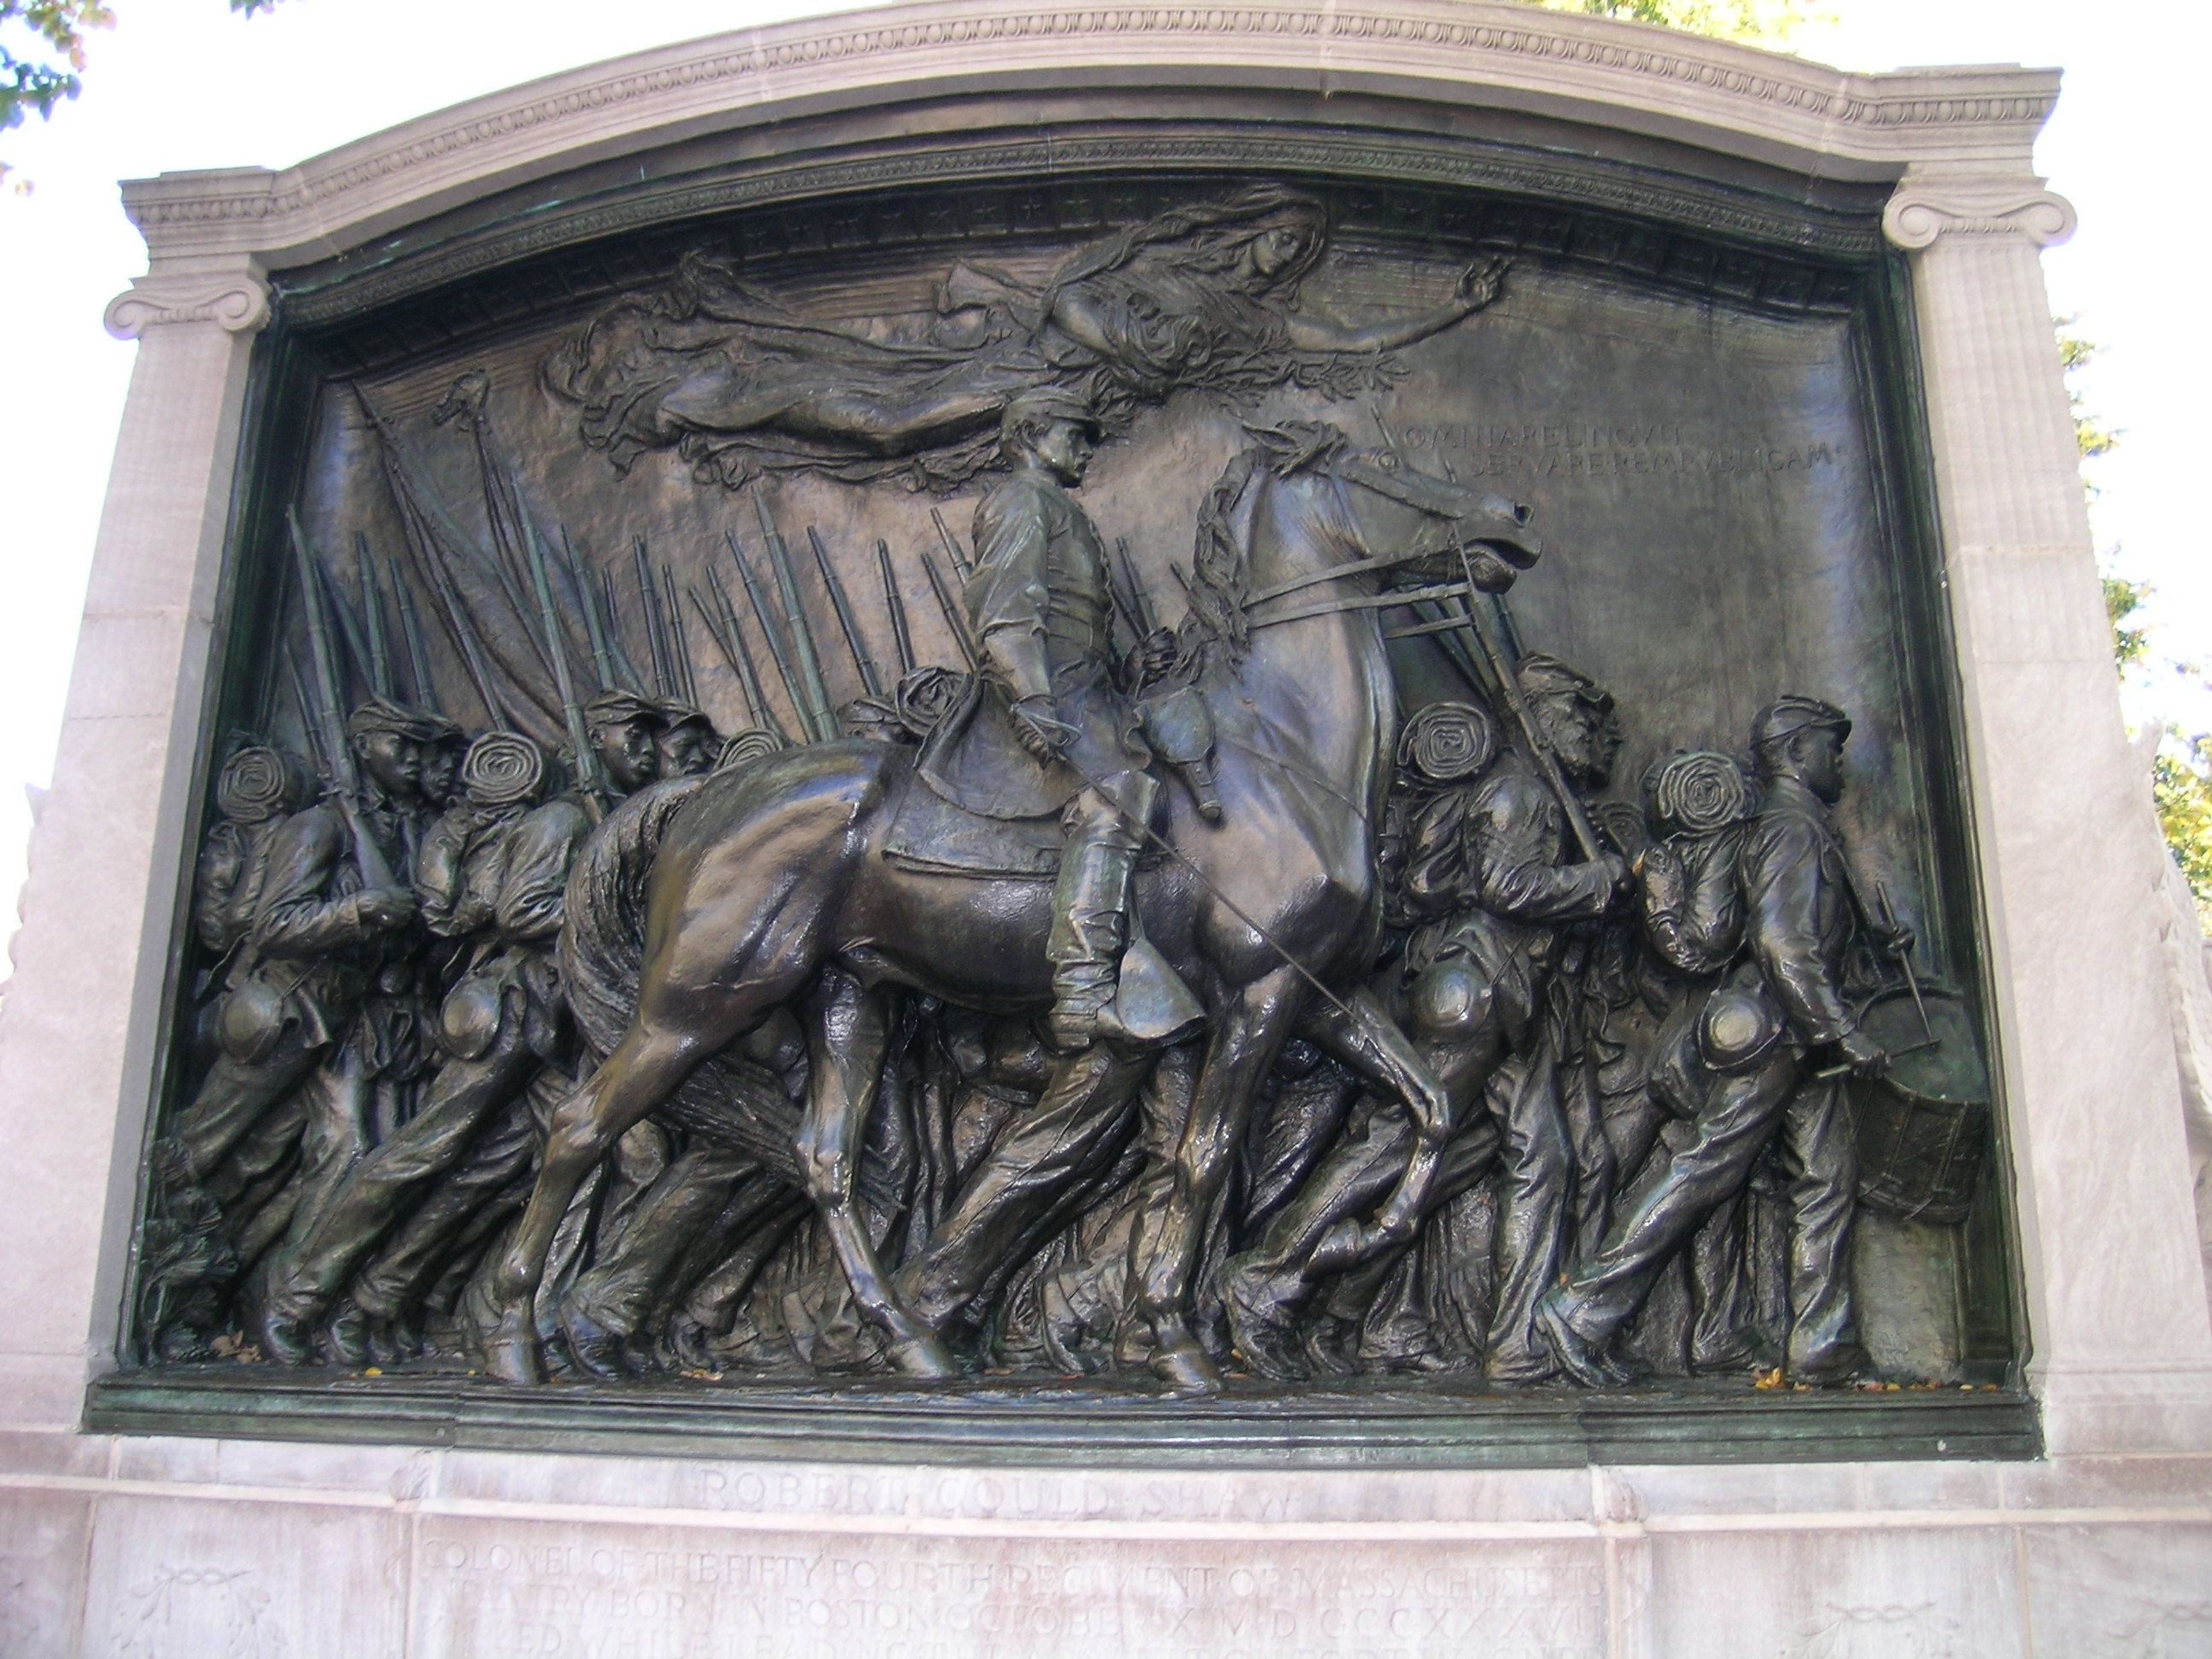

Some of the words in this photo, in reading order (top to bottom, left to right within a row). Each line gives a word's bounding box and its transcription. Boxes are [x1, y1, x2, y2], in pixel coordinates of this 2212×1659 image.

[700, 1469, 908, 1516] ROBERT
[1142, 1478, 1297, 1520] SHAW
[425, 1539, 574, 1578] COLONEL
[591, 1548, 638, 1580] OF
[645, 1551, 719, 1584] THE
[727, 1553, 824, 1588] FIFTY
[832, 1559, 995, 1596] FOURTH
[1006, 1562, 1217, 1599] REGIMENT
[1228, 1566, 1280, 1599] OF
[1291, 1565, 1605, 1601] MASSACHUSETTS
[783, 1596, 930, 1633] BOSTON
